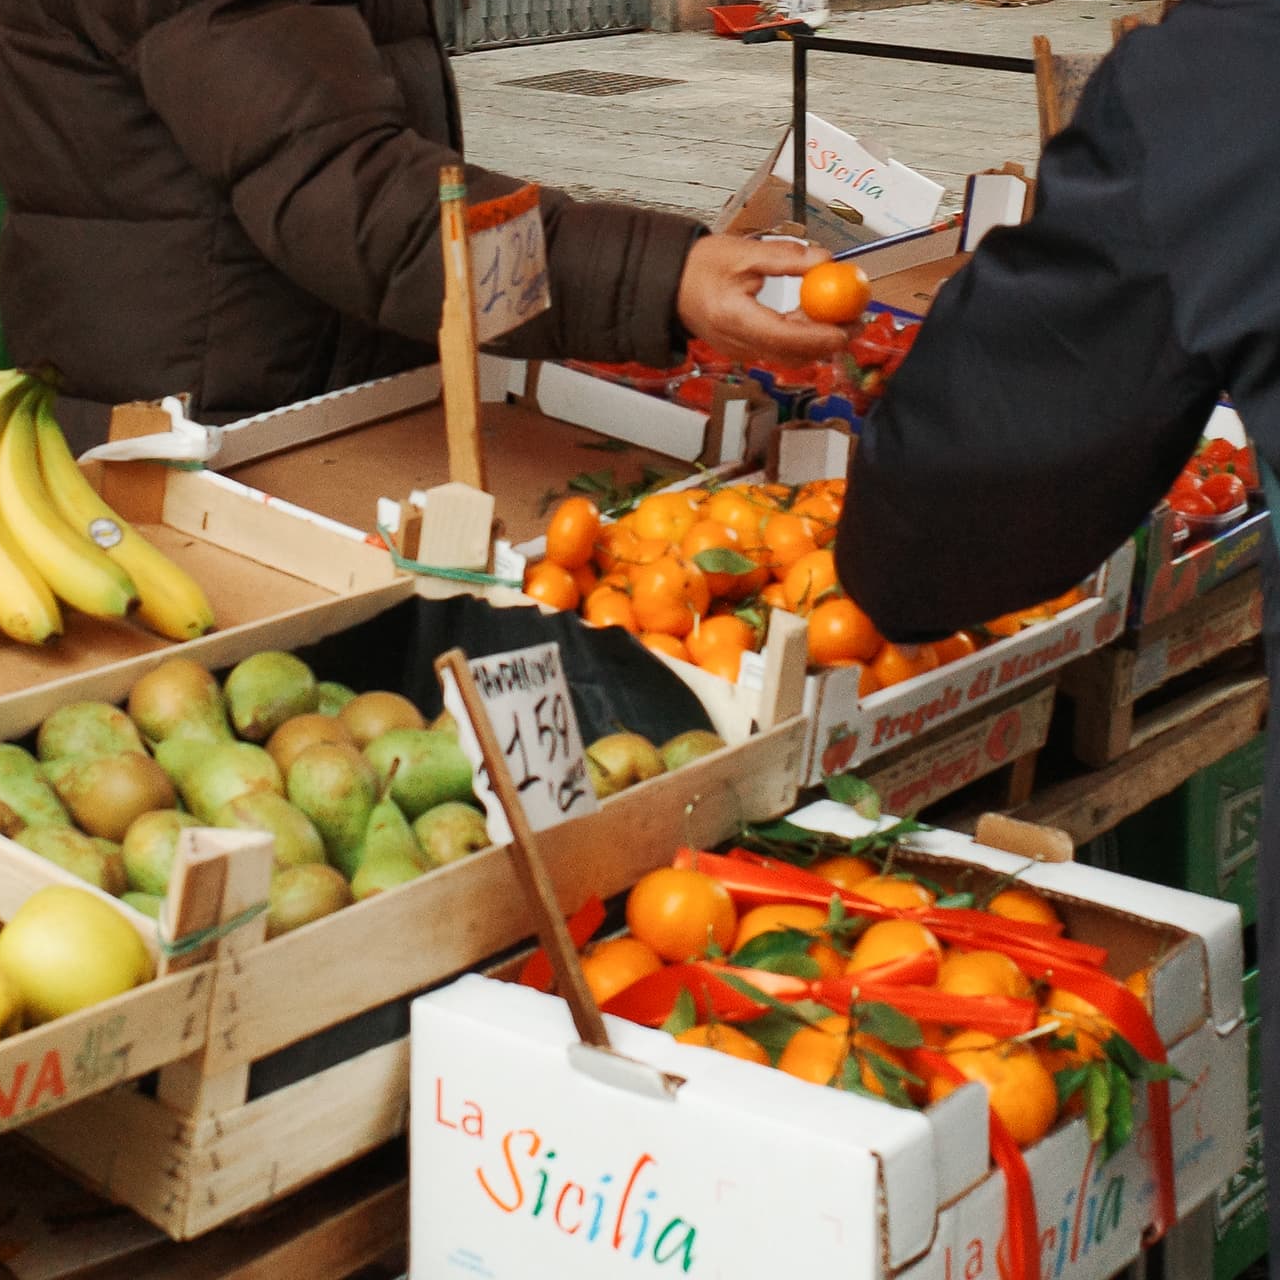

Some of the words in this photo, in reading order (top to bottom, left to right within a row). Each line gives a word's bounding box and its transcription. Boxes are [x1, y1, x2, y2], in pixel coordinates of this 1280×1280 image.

[807, 149, 886, 201] Sicilia
[434, 1076, 484, 1140] La
[475, 1127, 698, 1274] Sicilia
